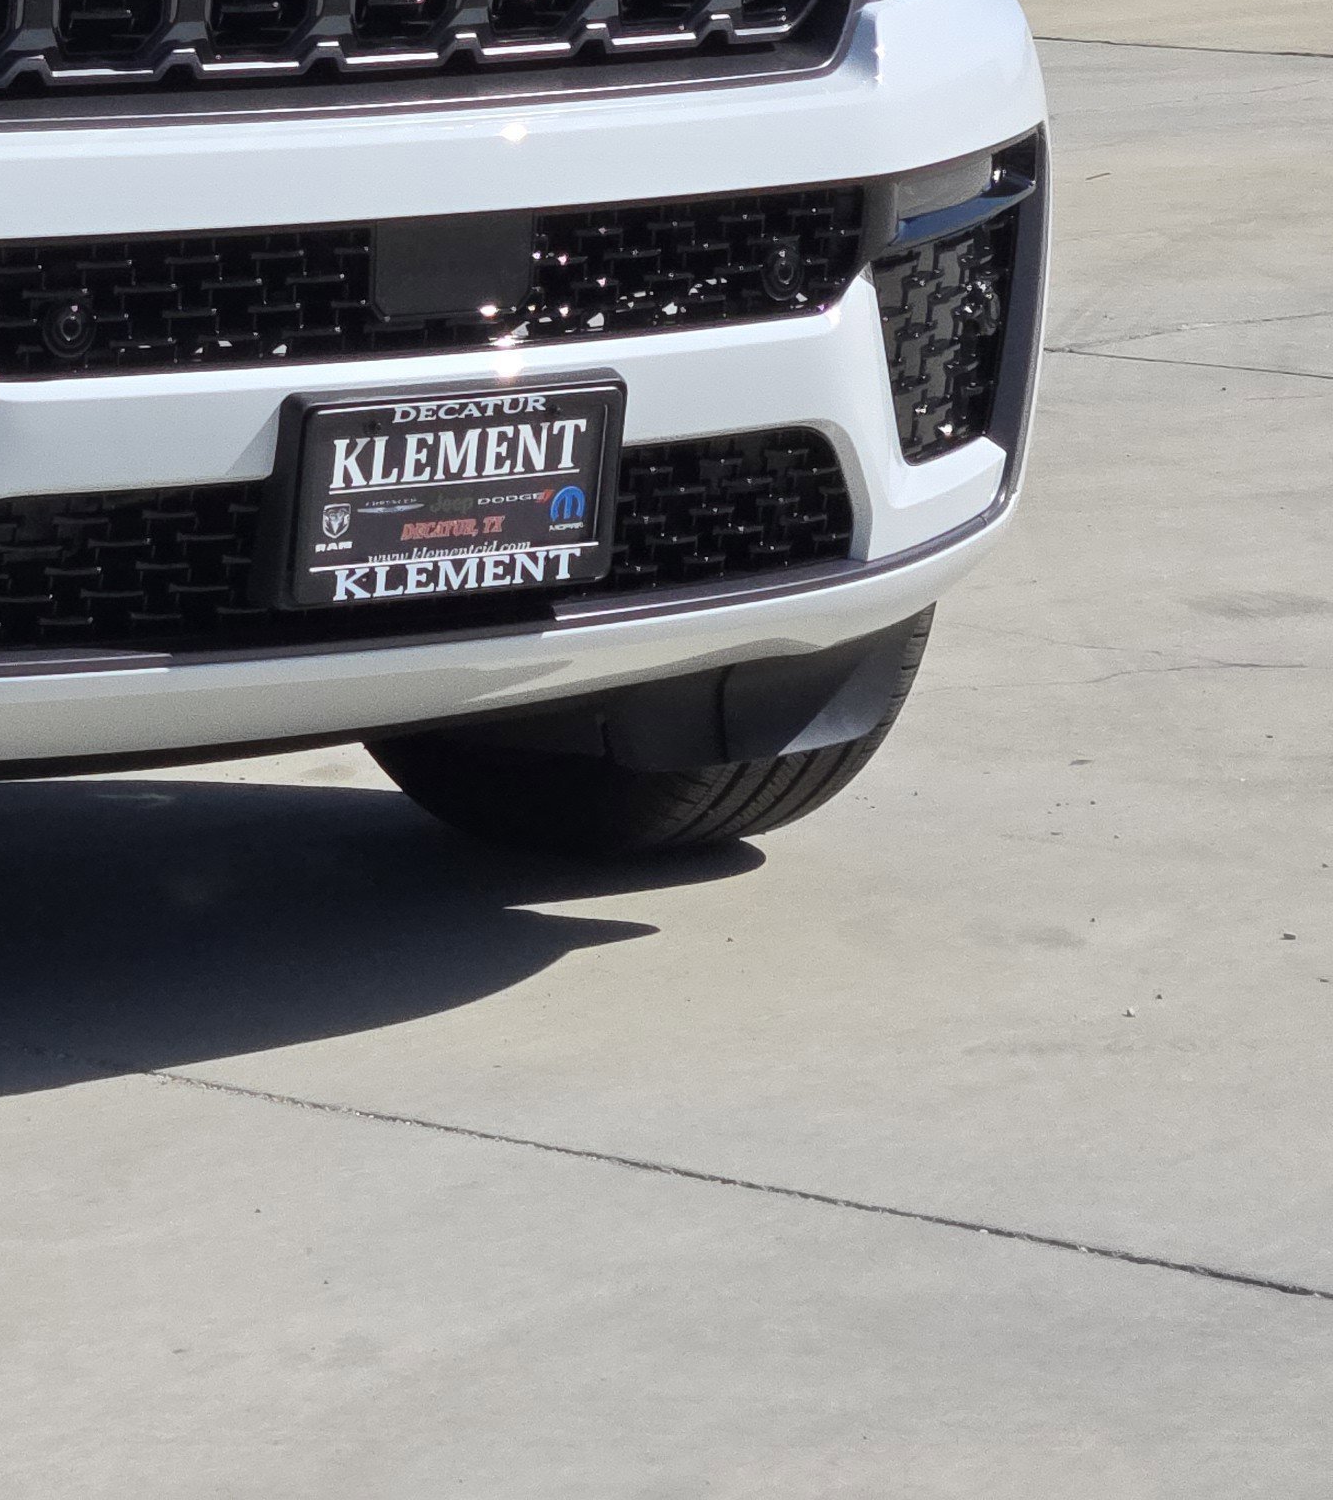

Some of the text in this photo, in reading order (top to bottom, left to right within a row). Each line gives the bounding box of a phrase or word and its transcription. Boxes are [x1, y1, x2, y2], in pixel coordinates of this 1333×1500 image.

[391, 396, 547, 424] DECATUR
[330, 418, 587, 490] KLEMENT
[477, 491, 542, 505] DODGE
[482, 515, 506, 534] TX
[315, 541, 353, 553] RAM
[333, 547, 582, 601] KLEMENT
